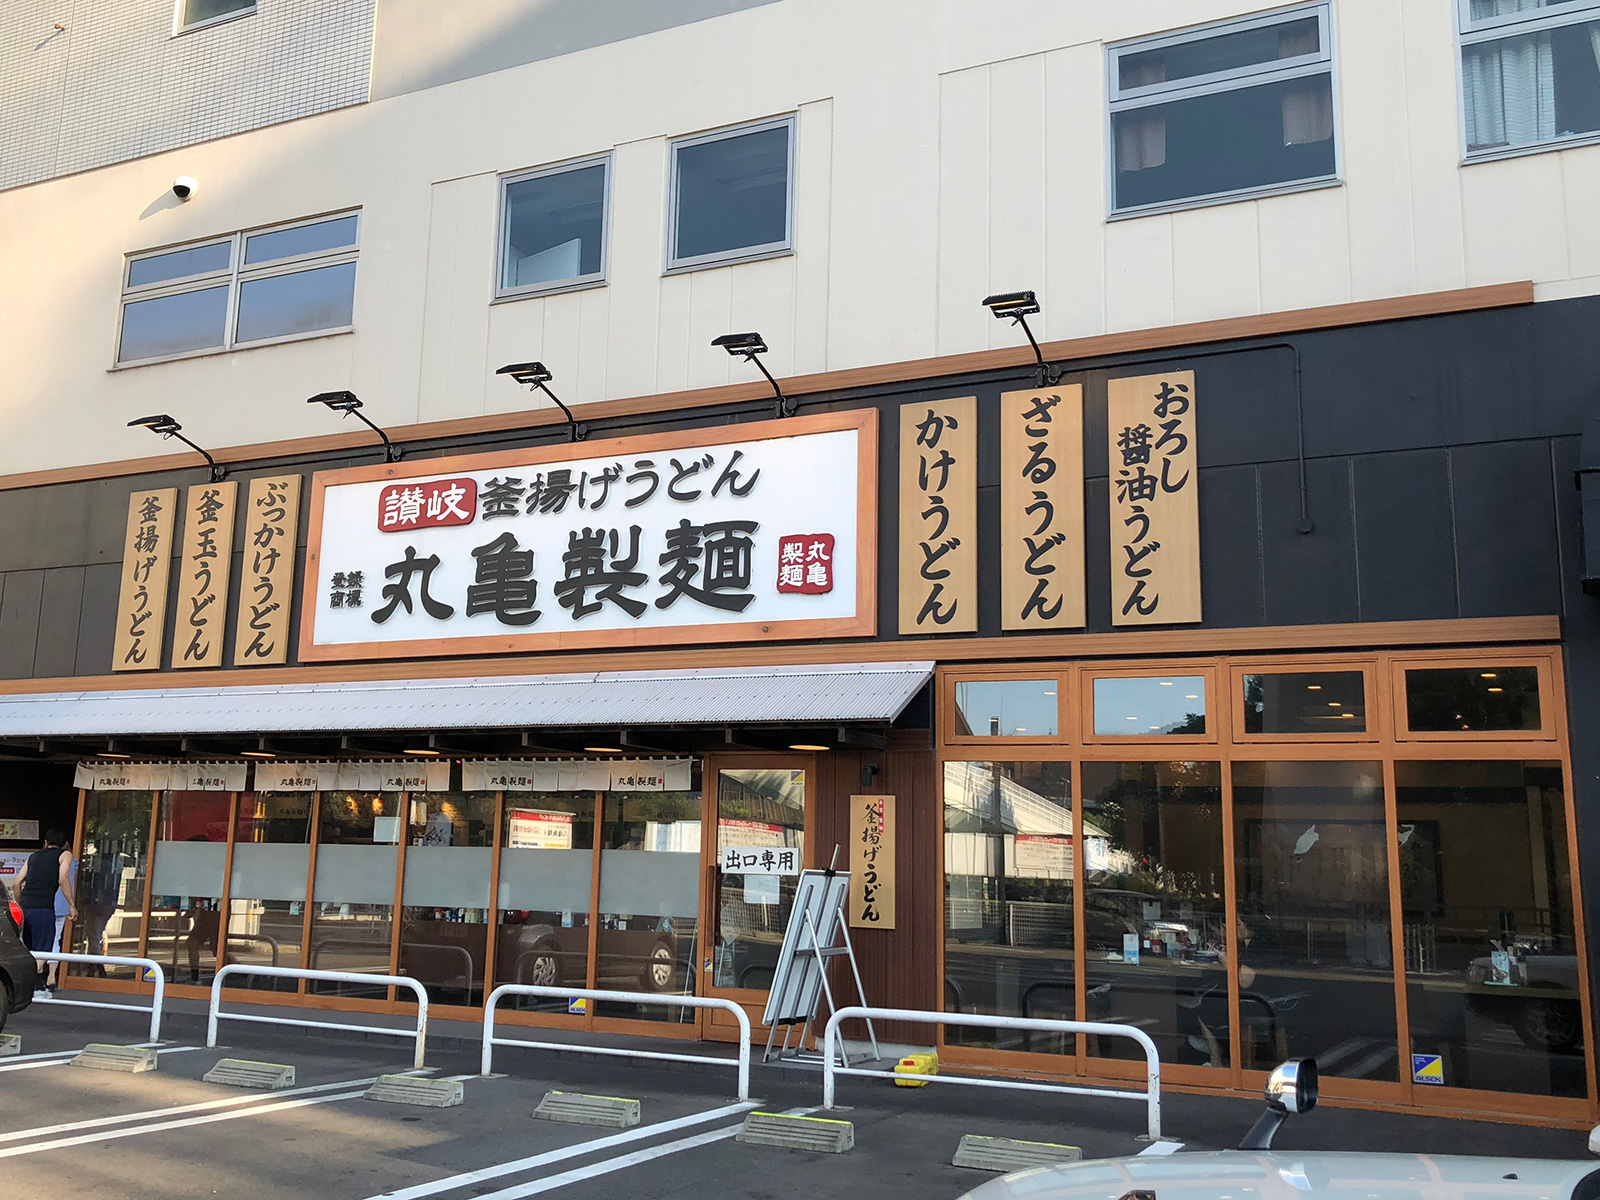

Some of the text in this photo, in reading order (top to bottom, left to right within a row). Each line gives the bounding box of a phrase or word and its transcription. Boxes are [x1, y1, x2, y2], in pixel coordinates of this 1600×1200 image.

[479, 450, 760, 521] 釜揚げうどん
[1153, 381, 1190, 493] おろし
[383, 483, 470, 527] 讃岐
[915, 409, 961, 626] かけうどん
[1021, 394, 1066, 621] ざるうどん
[1114, 423, 1161, 617] 醤油うどん
[124, 496, 163, 664] 釜揚げうどん
[183, 489, 225, 662] 釜玉うどん
[243, 481, 289, 658] ぶっかけうどん
[370, 518, 760, 626] 丸亀製麺
[726, 849, 794, 872] 出口専用
[862, 802, 882, 922] 釜揚げうどん
[1415, 1075, 1442, 1083] ALSOK
